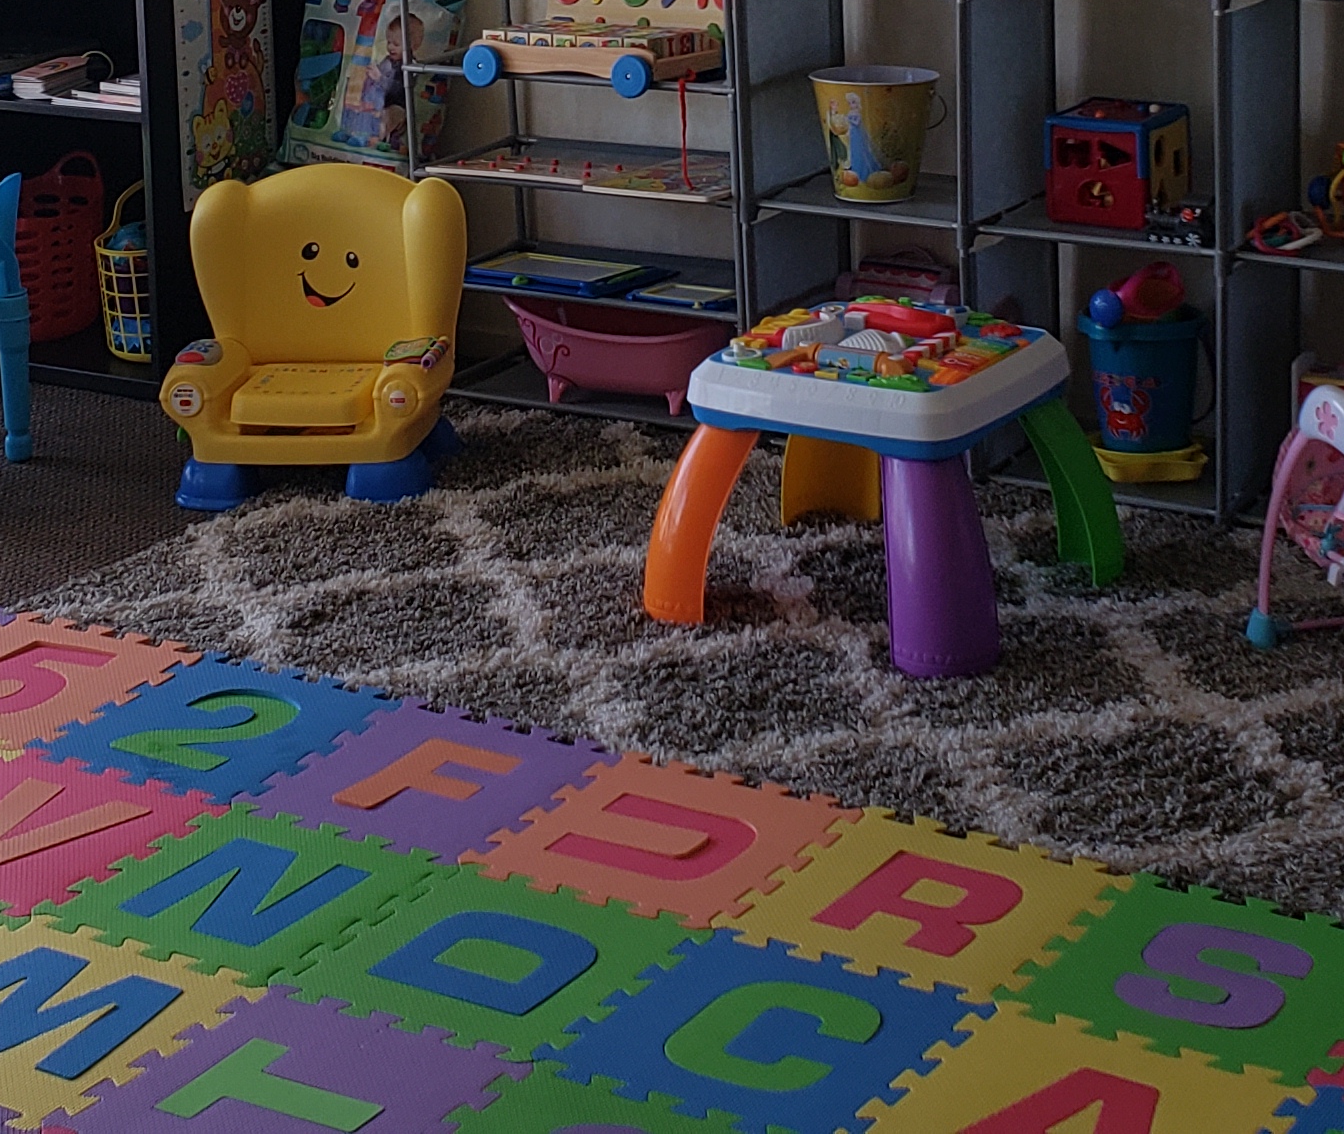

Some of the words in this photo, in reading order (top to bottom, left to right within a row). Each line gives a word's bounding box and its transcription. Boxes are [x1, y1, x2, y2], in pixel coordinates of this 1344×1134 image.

[111, 687, 302, 770] 2
[333, 739, 523, 809] F
[118, 837, 372, 947] N
[810, 851, 1025, 957] R
[367, 910, 597, 1016] D
[1113, 922, 1314, 1029] S
[157, 1038, 384, 1134] T
[664, 980, 883, 1091] C
